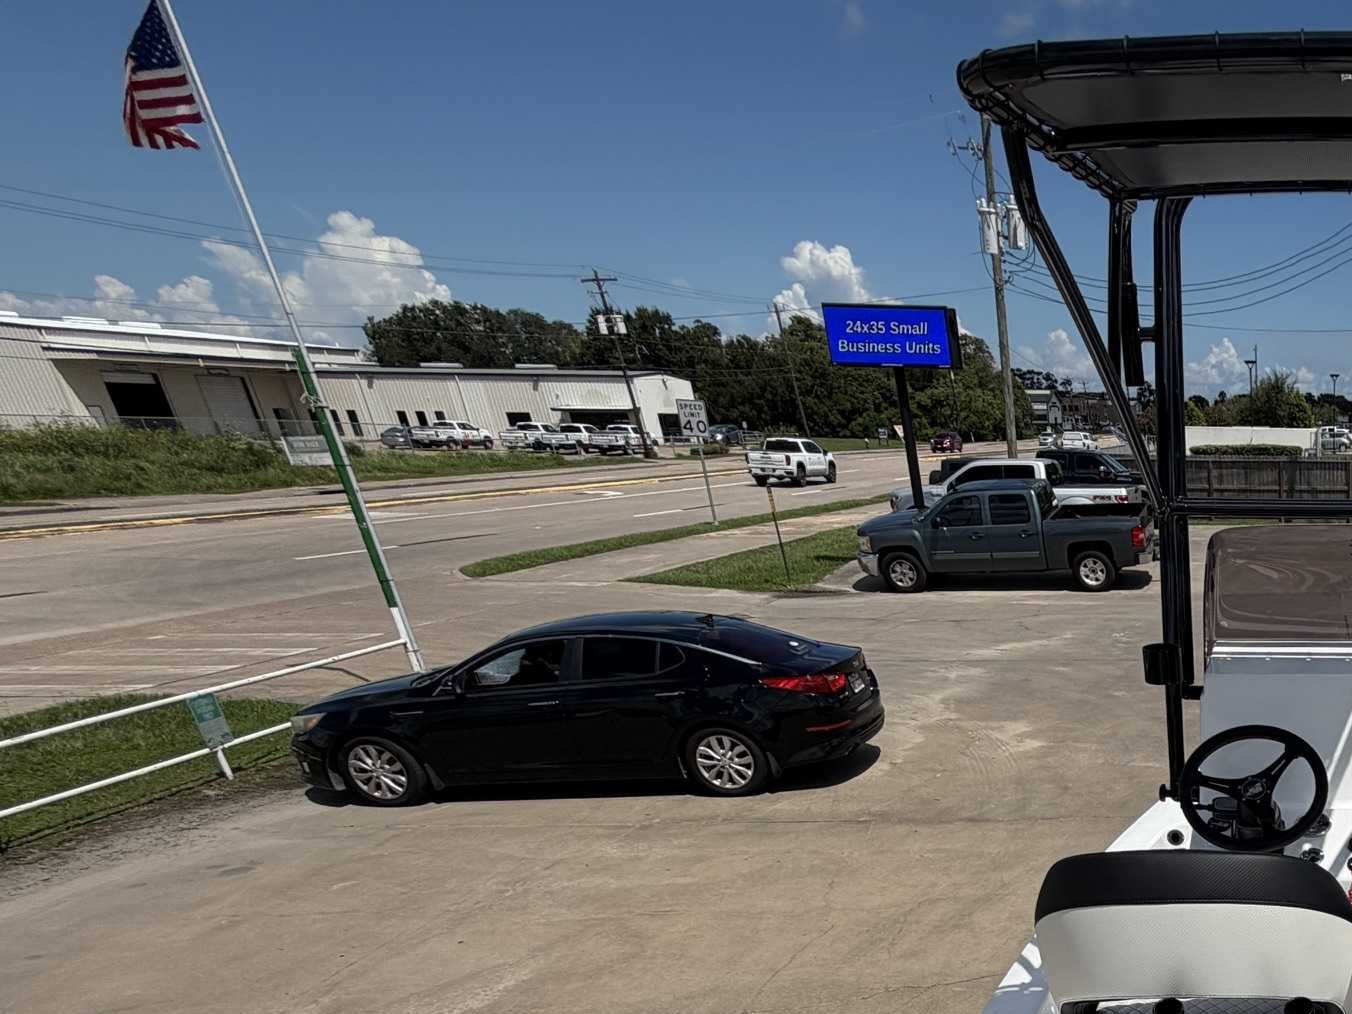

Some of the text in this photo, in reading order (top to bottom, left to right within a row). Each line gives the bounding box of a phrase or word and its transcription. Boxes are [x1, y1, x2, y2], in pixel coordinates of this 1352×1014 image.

[846, 320, 928, 335] 24x35 Small
[838, 339, 941, 354] Business Units
[679, 403, 703, 411] SPEED
[683, 420, 707, 433] 40
